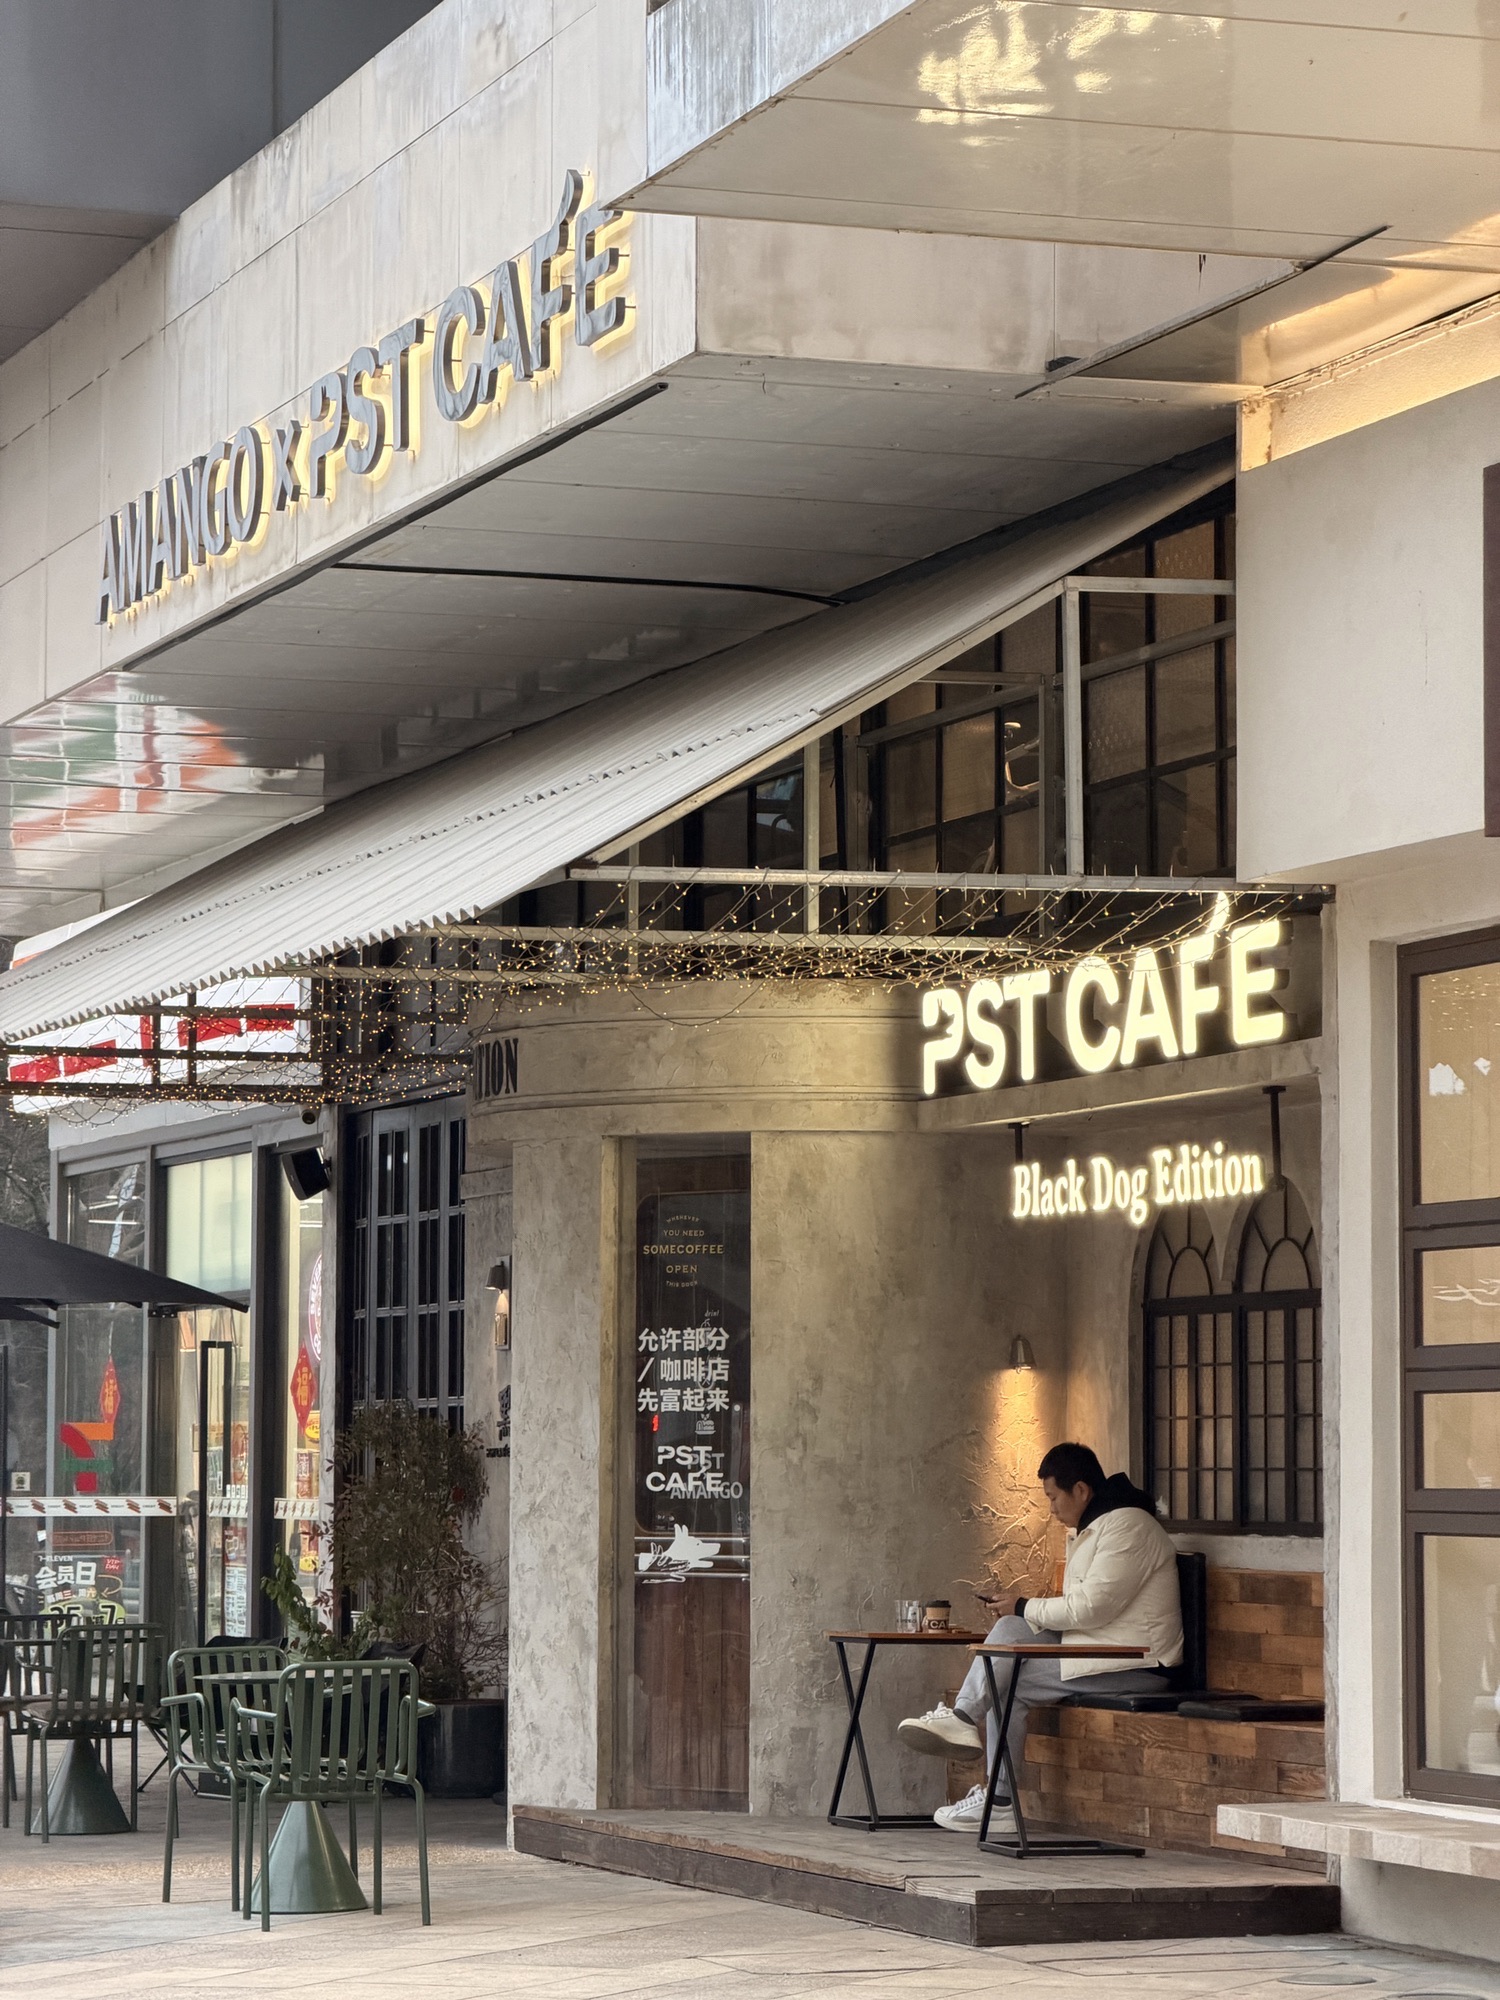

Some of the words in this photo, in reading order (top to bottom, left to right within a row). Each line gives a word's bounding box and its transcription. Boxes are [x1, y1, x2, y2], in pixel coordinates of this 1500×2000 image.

[94, 426, 264, 625] AMANGO
[310, 318, 427, 500] PST
[433, 169, 628, 422] CAFÉ
[922, 969, 1051, 1096] PST
[1066, 890, 1285, 1074] CAFÉ
[1012, 1158, 1087, 1218] Black
[1090, 1155, 1149, 1226] Dog
[1151, 1140, 1265, 1204] Edition
[663, 1229, 681, 1237] YOU
[682, 1229, 705, 1237] NEED
[643, 1244, 724, 1254] SOMECOFFEE
[665, 1265, 698, 1274] OPEN
[637, 1326, 731, 1353] 允许部分
[657, 1445, 713, 1466] PST
[669, 1481, 744, 1500] AMANGO
[34, 1561, 97, 1590] 会员日
